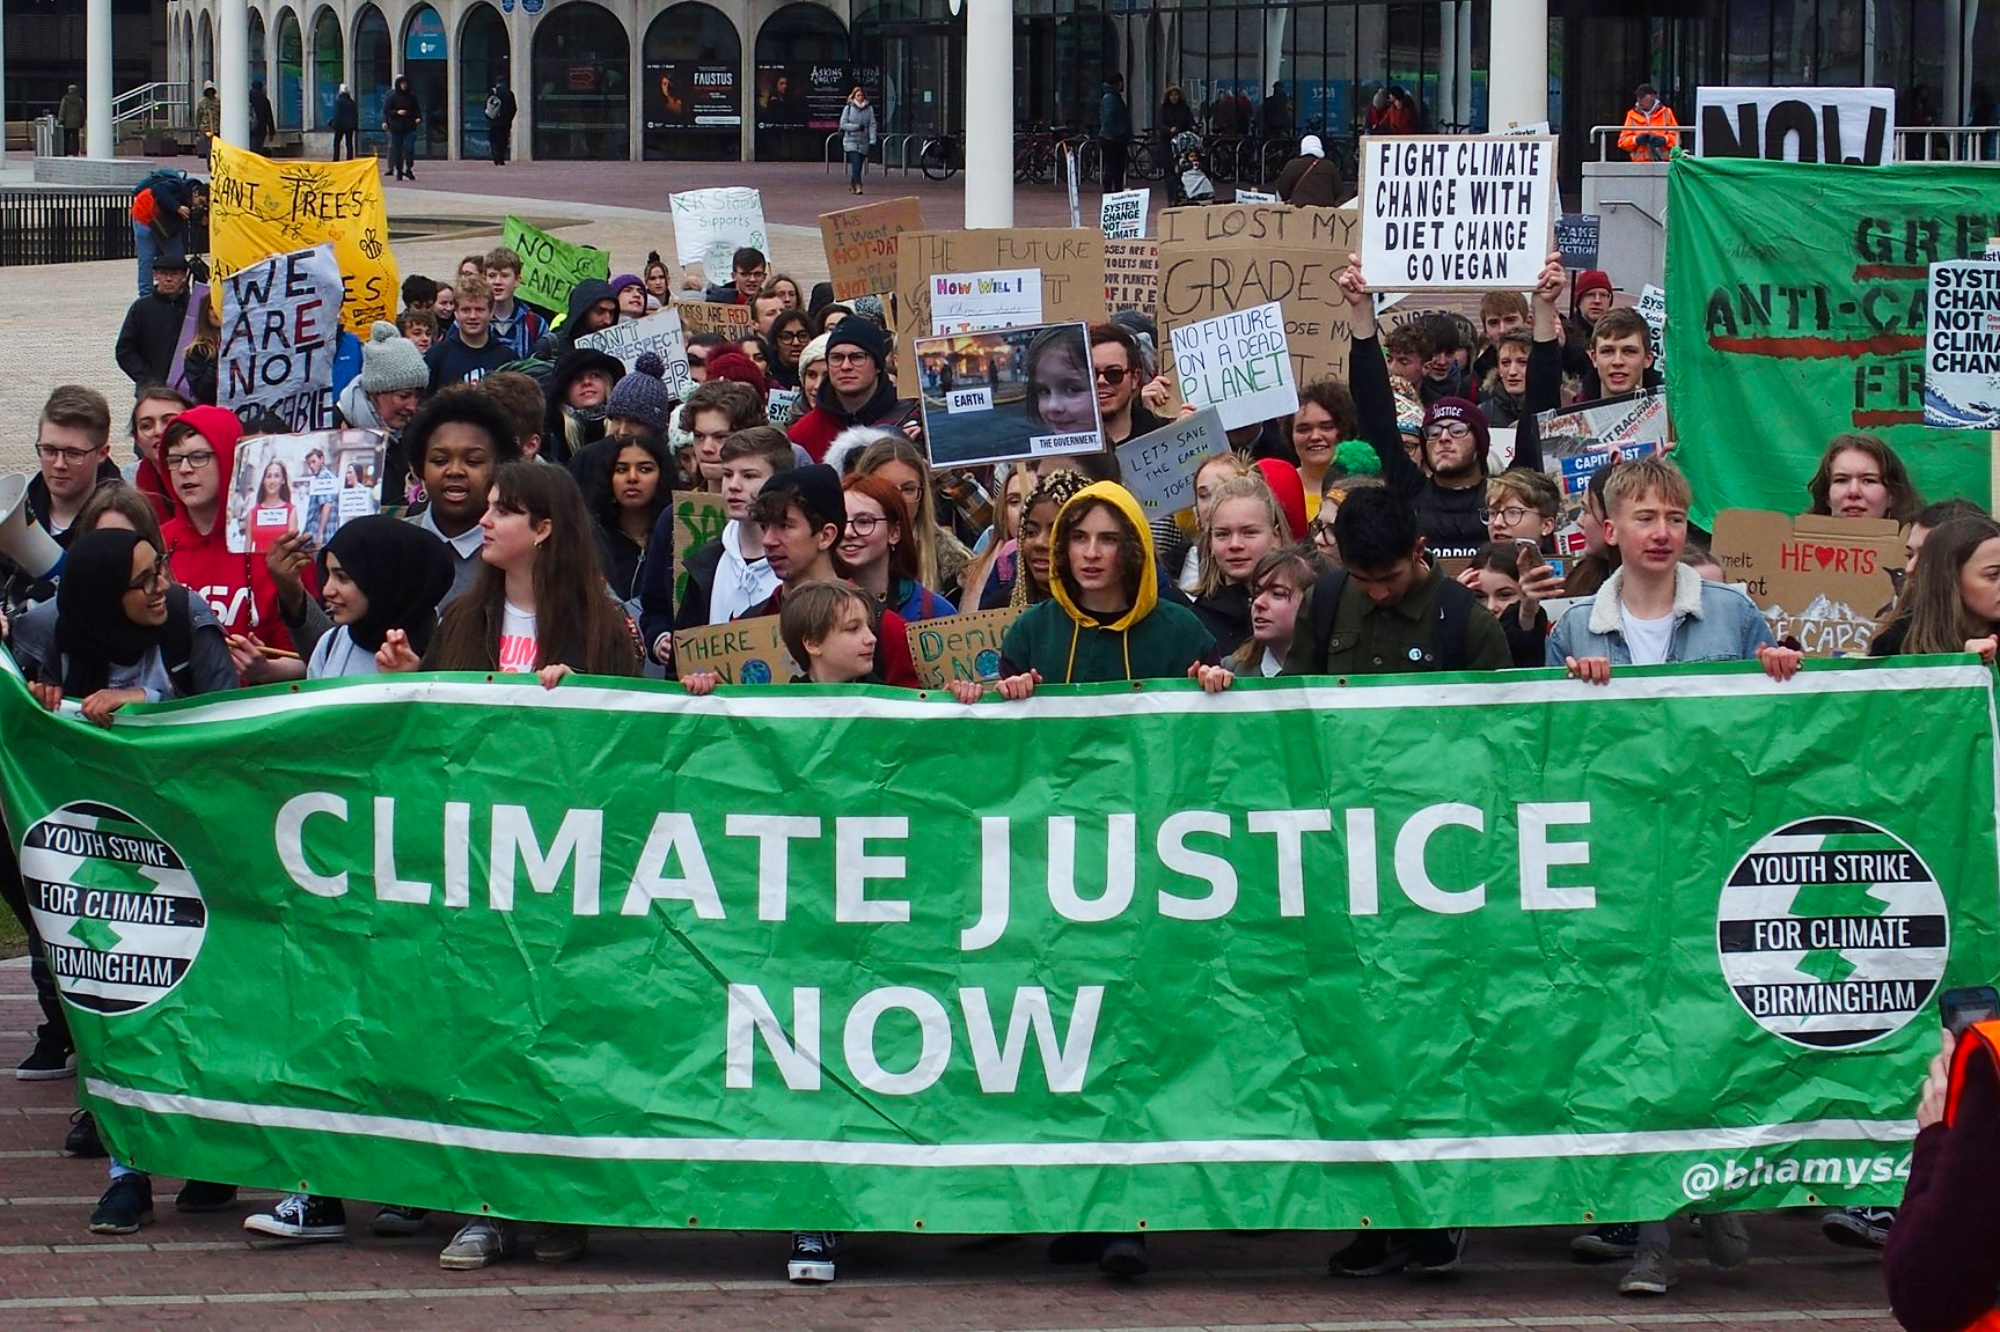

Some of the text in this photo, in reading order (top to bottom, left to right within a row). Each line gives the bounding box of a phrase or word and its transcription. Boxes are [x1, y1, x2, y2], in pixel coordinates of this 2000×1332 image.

[694, 73, 732, 85] FAUSTUS
[1702, 100, 1887, 166] NOW
[1380, 142, 1540, 176] FIGHT CLIMATE
[280, 175, 363, 222] TREES
[1103, 200, 1139, 213] SYSTEM
[1376, 178, 1532, 218] CHANGE WITH
[1103, 210, 1140, 222] CHANGE
[1103, 221, 1120, 231] NOT
[1206, 208, 1292, 241] LOST
[1312, 212, 1357, 247] MY
[516, 233, 554, 264] NO
[1129, 246, 1146, 256] ARE
[1385, 221, 1528, 250] DIET CHANGE
[1558, 245, 1598, 255] ACTION
[1856, 213, 2000, 263] GRE
[908, 234, 1090, 280] THE FUTURE
[1407, 252, 1507, 281] GO VEGAN
[232, 249, 316, 305] WE
[1017, 277, 1023, 293] I
[707, 306, 724, 323] ARE
[727, 308, 749, 325] RED
[1705, 284, 1928, 335] ANTI-CA
[1935, 289, 2000, 311] CHAN
[222, 299, 323, 357] ARE
[1174, 306, 1278, 352] NO FUTURE
[1285, 321, 1321, 335] OSE
[1935, 311, 1984, 331] NOT
[1179, 330, 1284, 376] ON A DEAD
[1932, 353, 2000, 374] CHAN
[229, 341, 325, 399] NOT
[1182, 349, 1287, 404] PLANET
[954, 393, 985, 407] EARTH
[1433, 404, 1464, 419] JUSTICE
[1039, 434, 1097, 449] THE GOVERNMENT
[1130, 426, 1207, 472] LETS SAVE
[1145, 443, 1209, 481] THE EARTH
[1575, 447, 1640, 470] CAPITIST
[1163, 471, 1196, 499] TOGE
[679, 630, 756, 662] THERE
[1801, 621, 1872, 653] CAPS
[43, 824, 168, 867] YOUTH STRIKE
[274, 791, 1597, 951] CLIMATE JUSTICE
[1750, 853, 1911, 884] YOUTH STRIKE
[40, 883, 175, 925] FOR CLIMATE
[1754, 918, 1911, 950] FOR CLIMATE
[51, 945, 173, 986] IRMINGHAM
[1753, 981, 1916, 1016] BIRMINGHAM
[724, 983, 1106, 1096] NOW
[1682, 1150, 1913, 1200] @bhamys4
